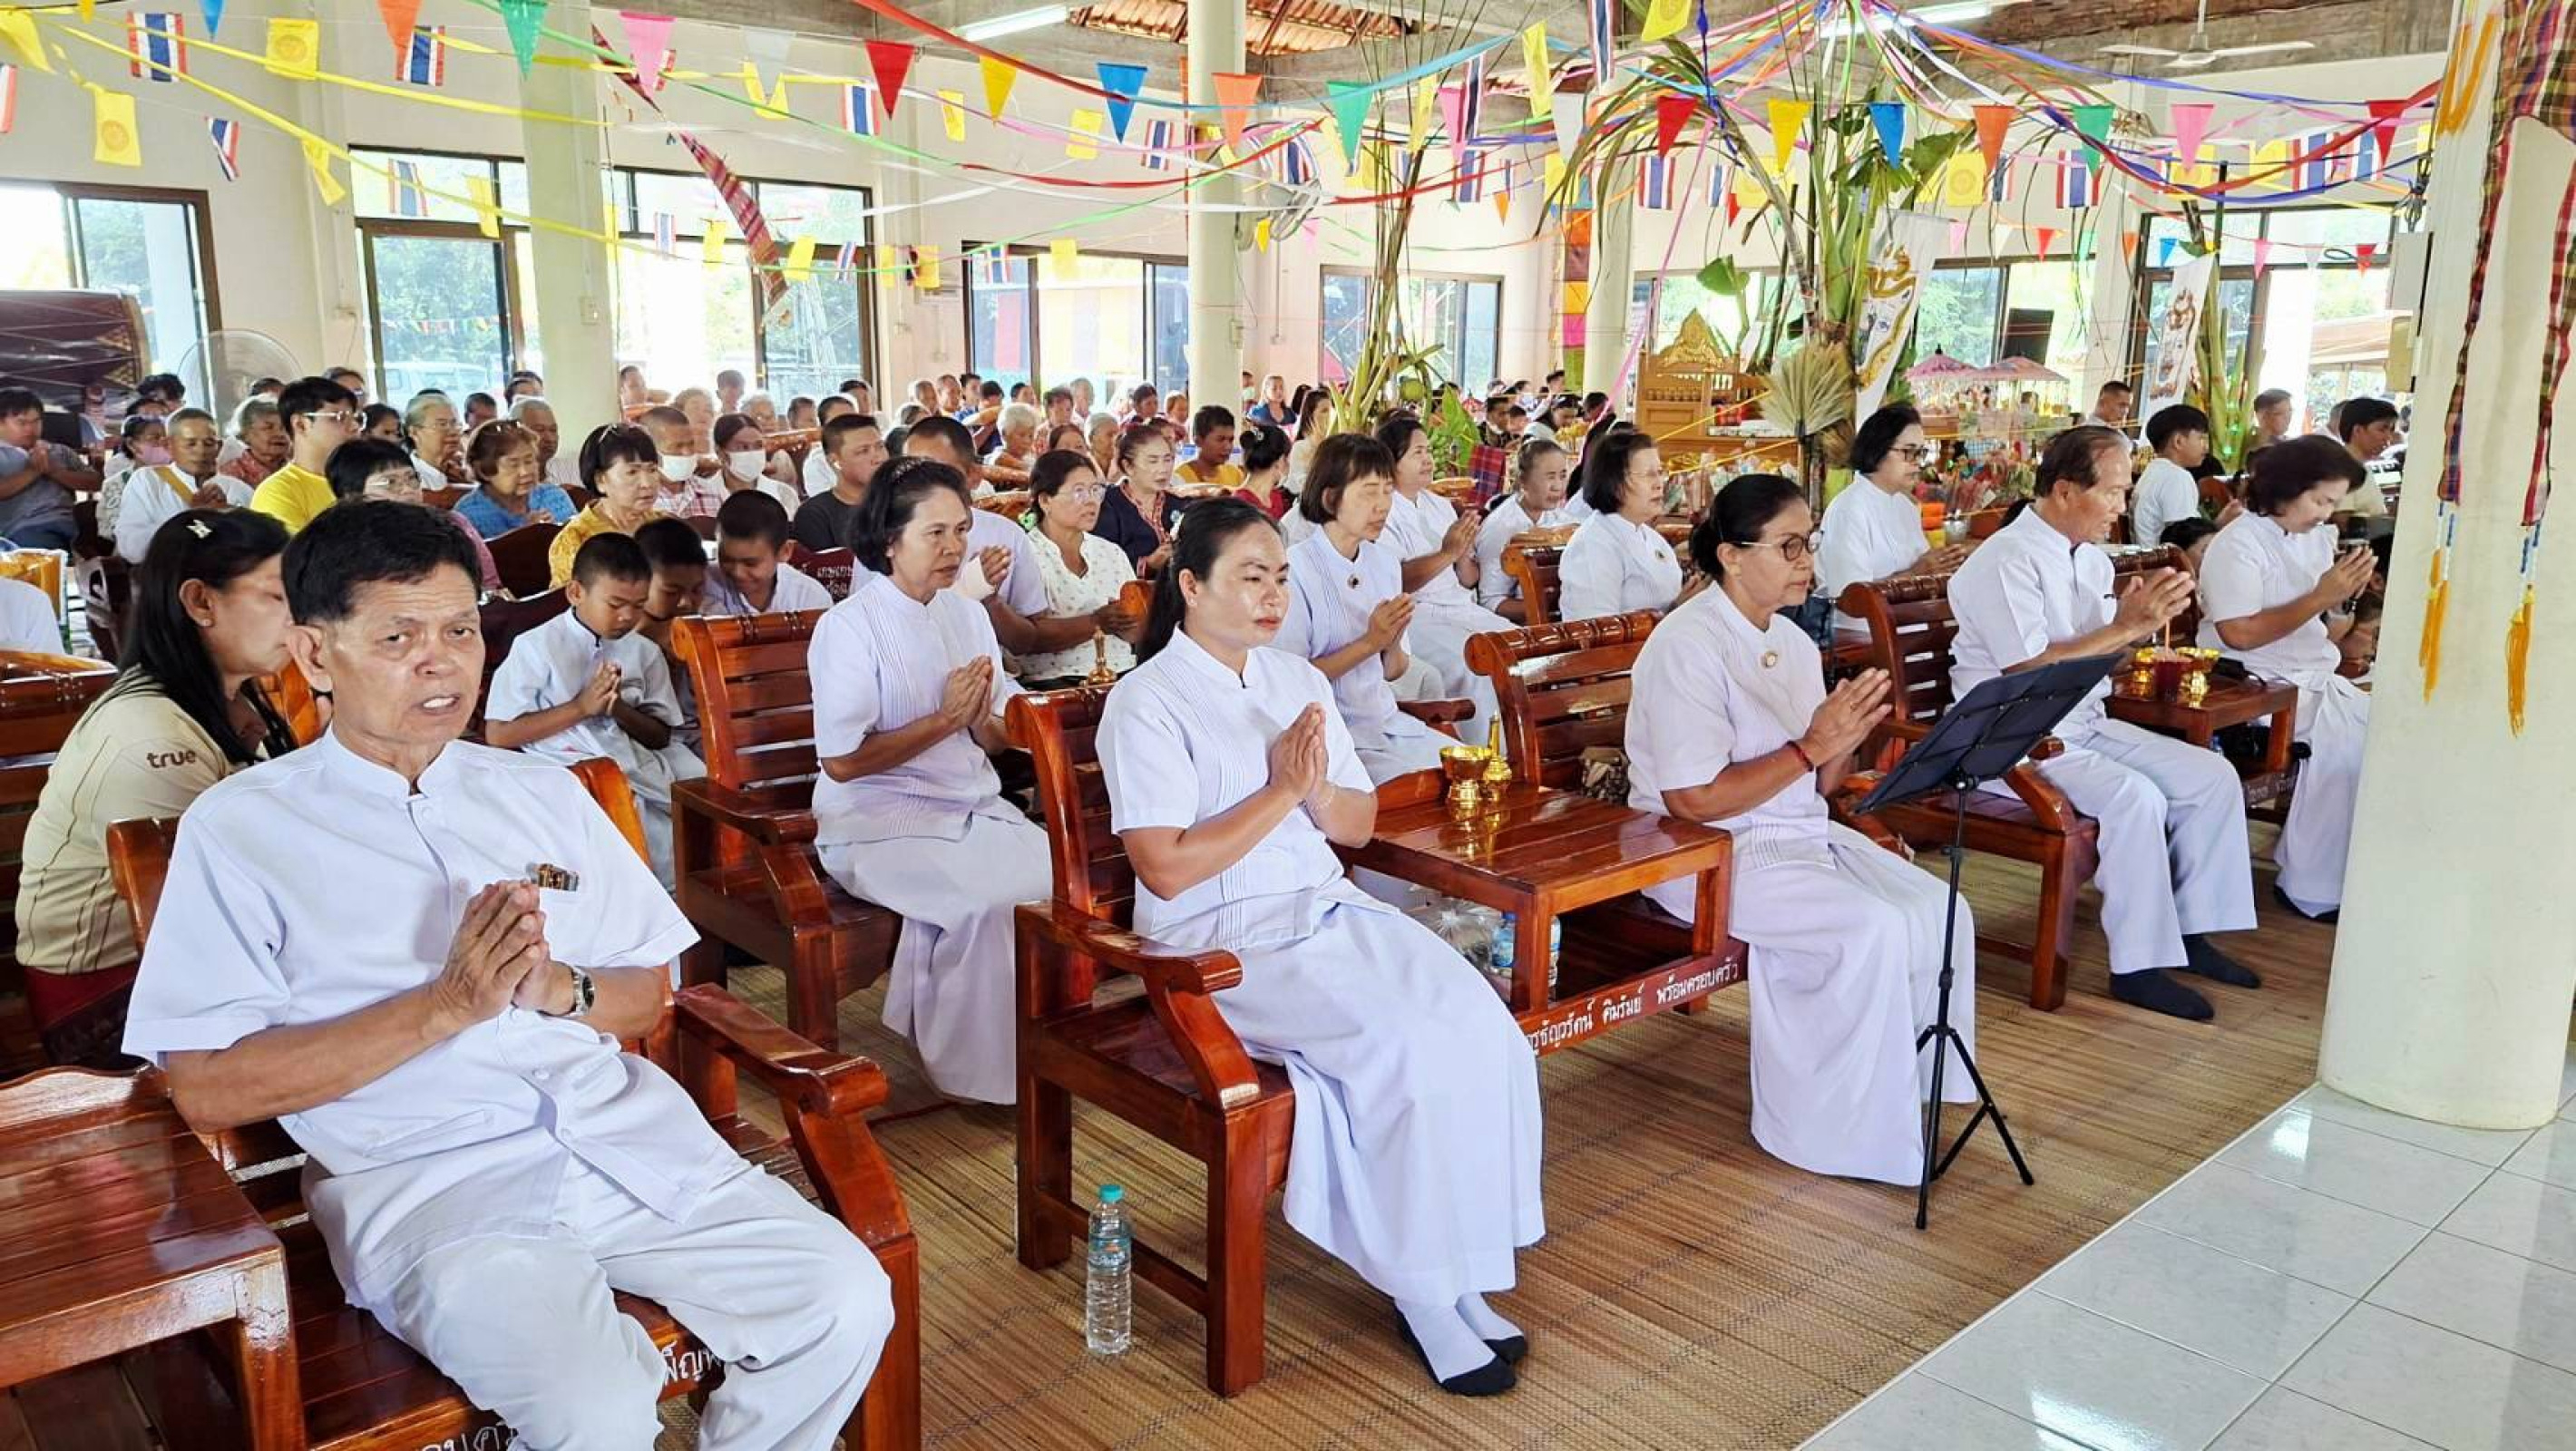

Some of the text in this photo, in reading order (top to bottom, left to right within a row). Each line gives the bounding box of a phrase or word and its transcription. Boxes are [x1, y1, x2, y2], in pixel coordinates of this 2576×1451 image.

[147, 750, 196, 768] true
[1656, 955, 1739, 1005] พร้อมครอบครัว
